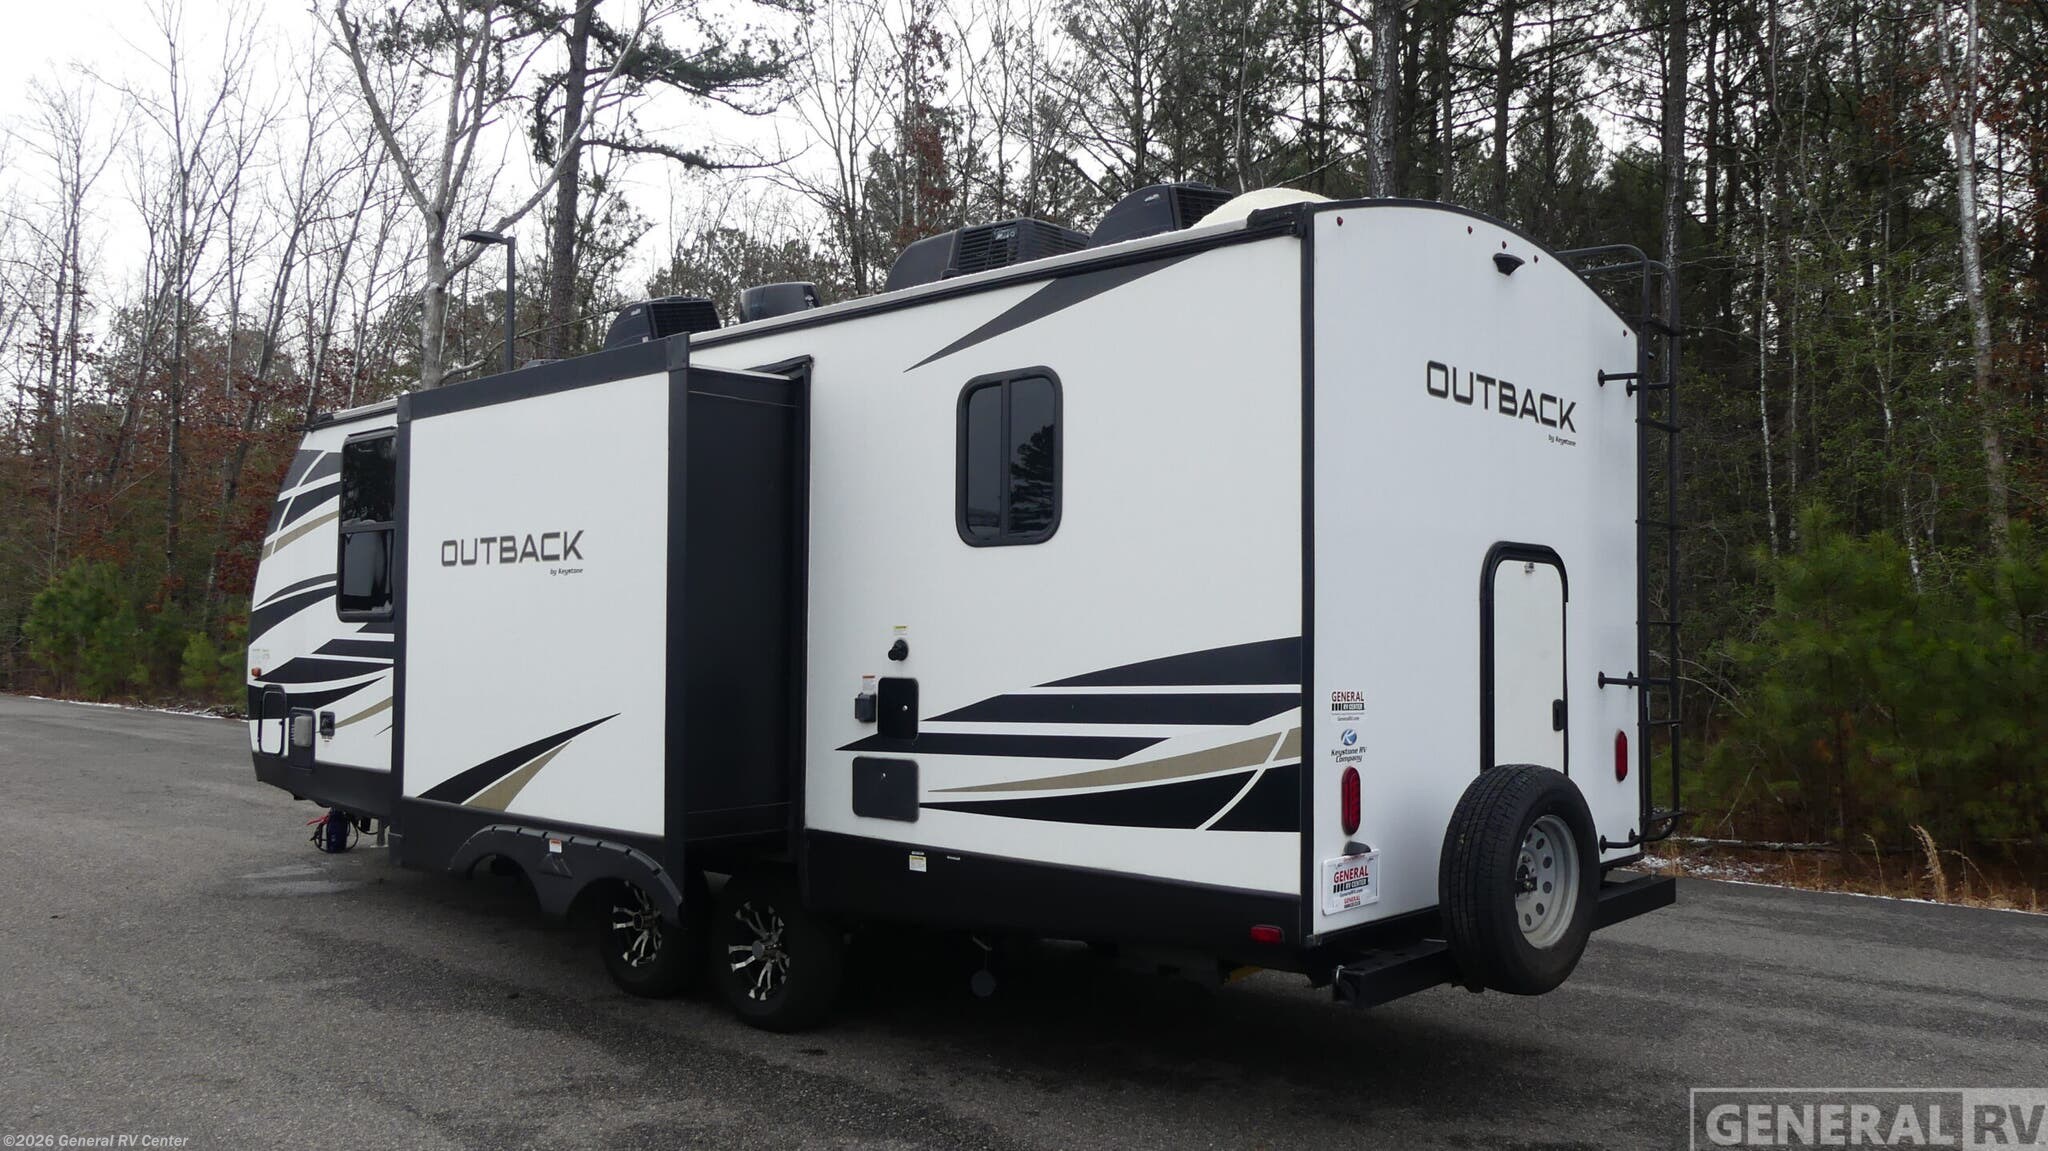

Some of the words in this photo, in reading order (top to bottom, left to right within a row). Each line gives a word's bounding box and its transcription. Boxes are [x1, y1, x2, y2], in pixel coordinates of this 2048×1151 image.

[1427, 360, 1577, 433] OUTBACK
[441, 530, 584, 567] OUTBACK
[558, 568, 583, 576] Keystone
[1331, 691, 1364, 702] GENERAL
[1331, 749, 1358, 757] Keystone
[1359, 746, 1367, 754] RV
[1336, 755, 1362, 763] Company
[1333, 865, 1368, 883] GENERAL
